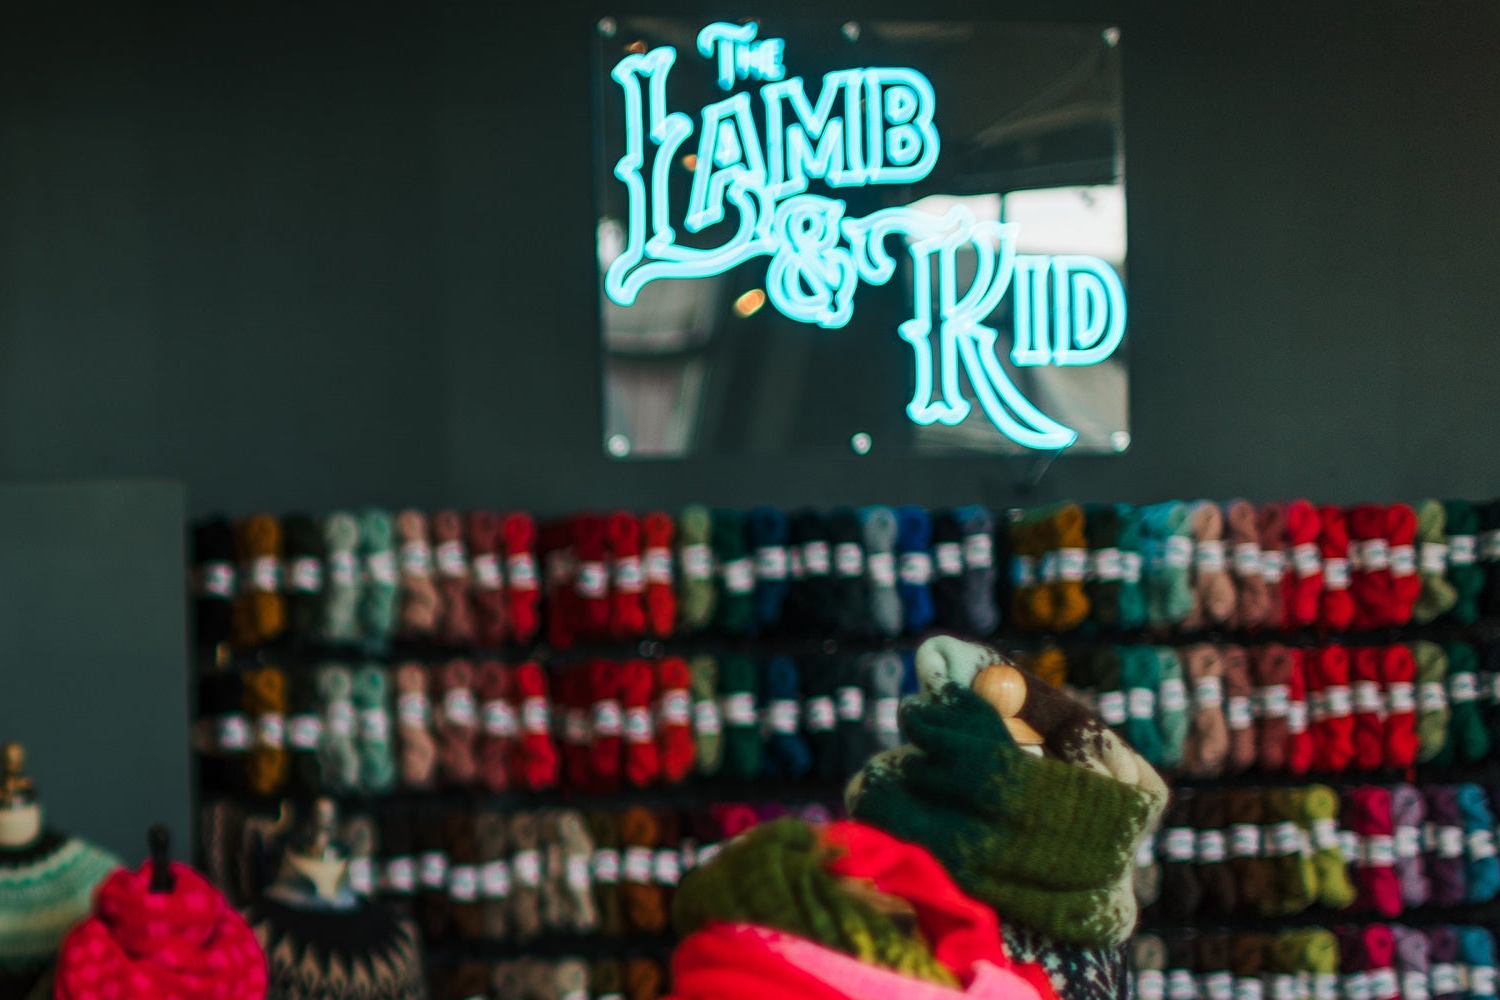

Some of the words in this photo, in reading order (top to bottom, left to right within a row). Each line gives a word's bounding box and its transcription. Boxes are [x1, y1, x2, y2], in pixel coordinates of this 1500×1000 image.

[604, 46, 941, 307] LAMB
[696, 20, 786, 90] THE
[765, 193, 859, 329] &
[842, 203, 1128, 450] KID
